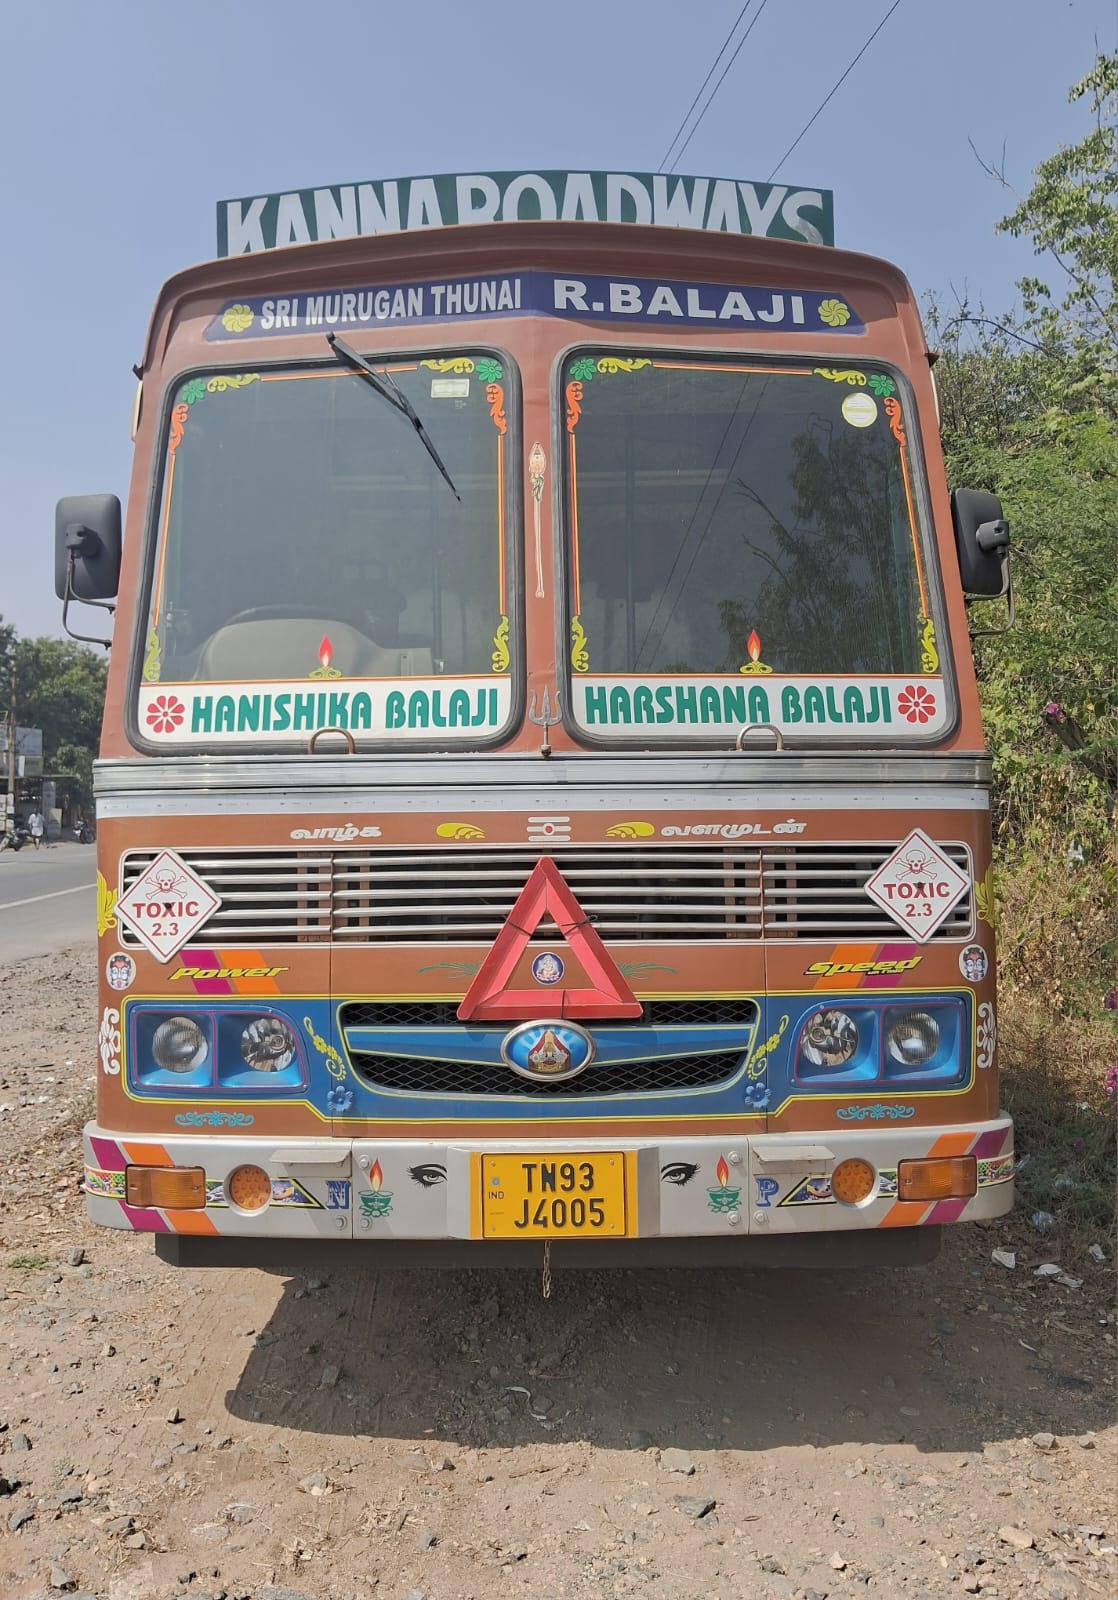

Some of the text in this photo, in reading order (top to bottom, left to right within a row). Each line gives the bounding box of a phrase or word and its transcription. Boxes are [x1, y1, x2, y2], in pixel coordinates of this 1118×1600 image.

[226, 173, 824, 256] KANNA ROADWAYS
[261, 278, 521, 329] SRI MURUGAN THUNAI
[553, 279, 805, 324] R.BALAJI
[191, 688, 499, 733] HANISHIKA BALAJI
[585, 685, 892, 725] HARSHANA BALAJI
[290, 818, 807, 841] வாழ்க வளமுடன்
[883, 882, 950, 899] TOXIC
[132, 901, 199, 918] TOXIC
[905, 903, 933, 917] 2.3
[151, 922, 179, 936] 2.3
[168, 967, 289, 980] Power
[804, 956, 923, 976] Speed
[521, 1162, 594, 1193] TN93
[488, 1191, 504, 1200] IND
[514, 1198, 605, 1229] J4005
